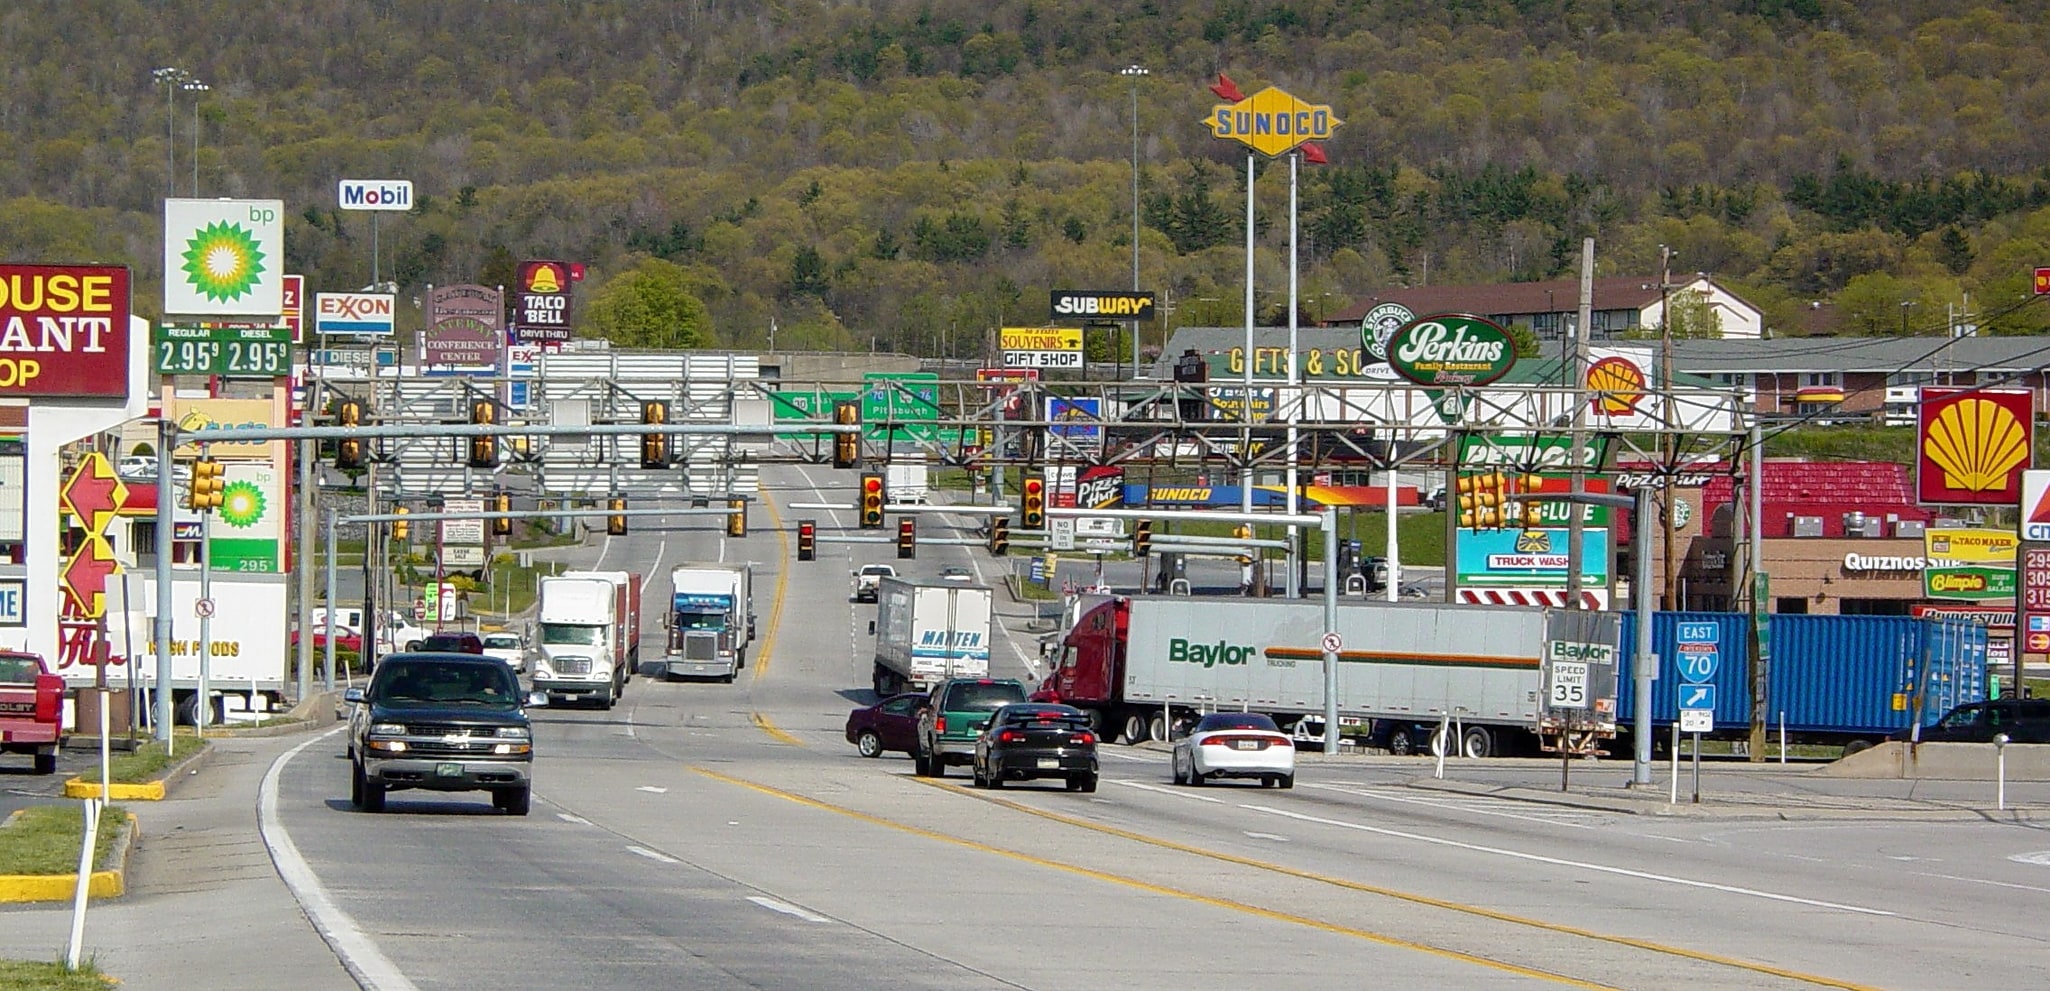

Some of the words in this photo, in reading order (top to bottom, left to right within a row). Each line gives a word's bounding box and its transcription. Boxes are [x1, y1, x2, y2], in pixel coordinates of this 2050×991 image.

[1217, 109, 1328, 135] SUNOCO
[344, 185, 408, 205] Mobil
[249, 204, 275, 227] bp
[0, 274, 113, 312] USE
[320, 295, 391, 321] EXXON
[524, 295, 566, 310] TACO
[1054, 296, 1152, 315] SUBWAY
[524, 310, 564, 324] BELL
[168, 329, 211, 338] REGULAR
[240, 330, 273, 338] DIESEL
[519, 329, 545, 338] DRIVE
[545, 329, 568, 339] THRU
[427, 340, 495, 350] CONFERENCE
[1002, 335, 1064, 349] SOUVENIRS
[1398, 322, 1504, 363] Perkins
[330, 352, 373, 364] DIESE
[440, 352, 481, 361] CENTER
[1004, 352, 1036, 365] GIFT
[1040, 353, 1078, 366] SHOP
[1230, 347, 1290, 374] GFTS
[1307, 348, 1323, 376] &
[1415, 362, 1443, 372] Family
[1445, 361, 1492, 371] Restaurant
[872, 406, 928, 418] Pitsburgh
[256, 471, 272, 485] bp
[1077, 475, 1124, 505] Pizza
[1086, 486, 1120, 509] Hut
[1959, 537, 1981, 546] TACO
[1982, 537, 2012, 547] MAKER
[1494, 557, 1535, 567] TRUCK
[1844, 553, 1925, 571] Quiznos
[1931, 574, 1984, 592] Blimpie
[1683, 627, 1713, 639] EAST
[192, 640, 240, 657] FODS
[1168, 638, 1257, 669] Baylor
[1553, 641, 1611, 661] Baylor
[1554, 665, 1586, 675] SPEED
[1684, 656, 1712, 675] 70
[1557, 675, 1582, 683] LIMIT
[1554, 684, 1583, 702] 35
